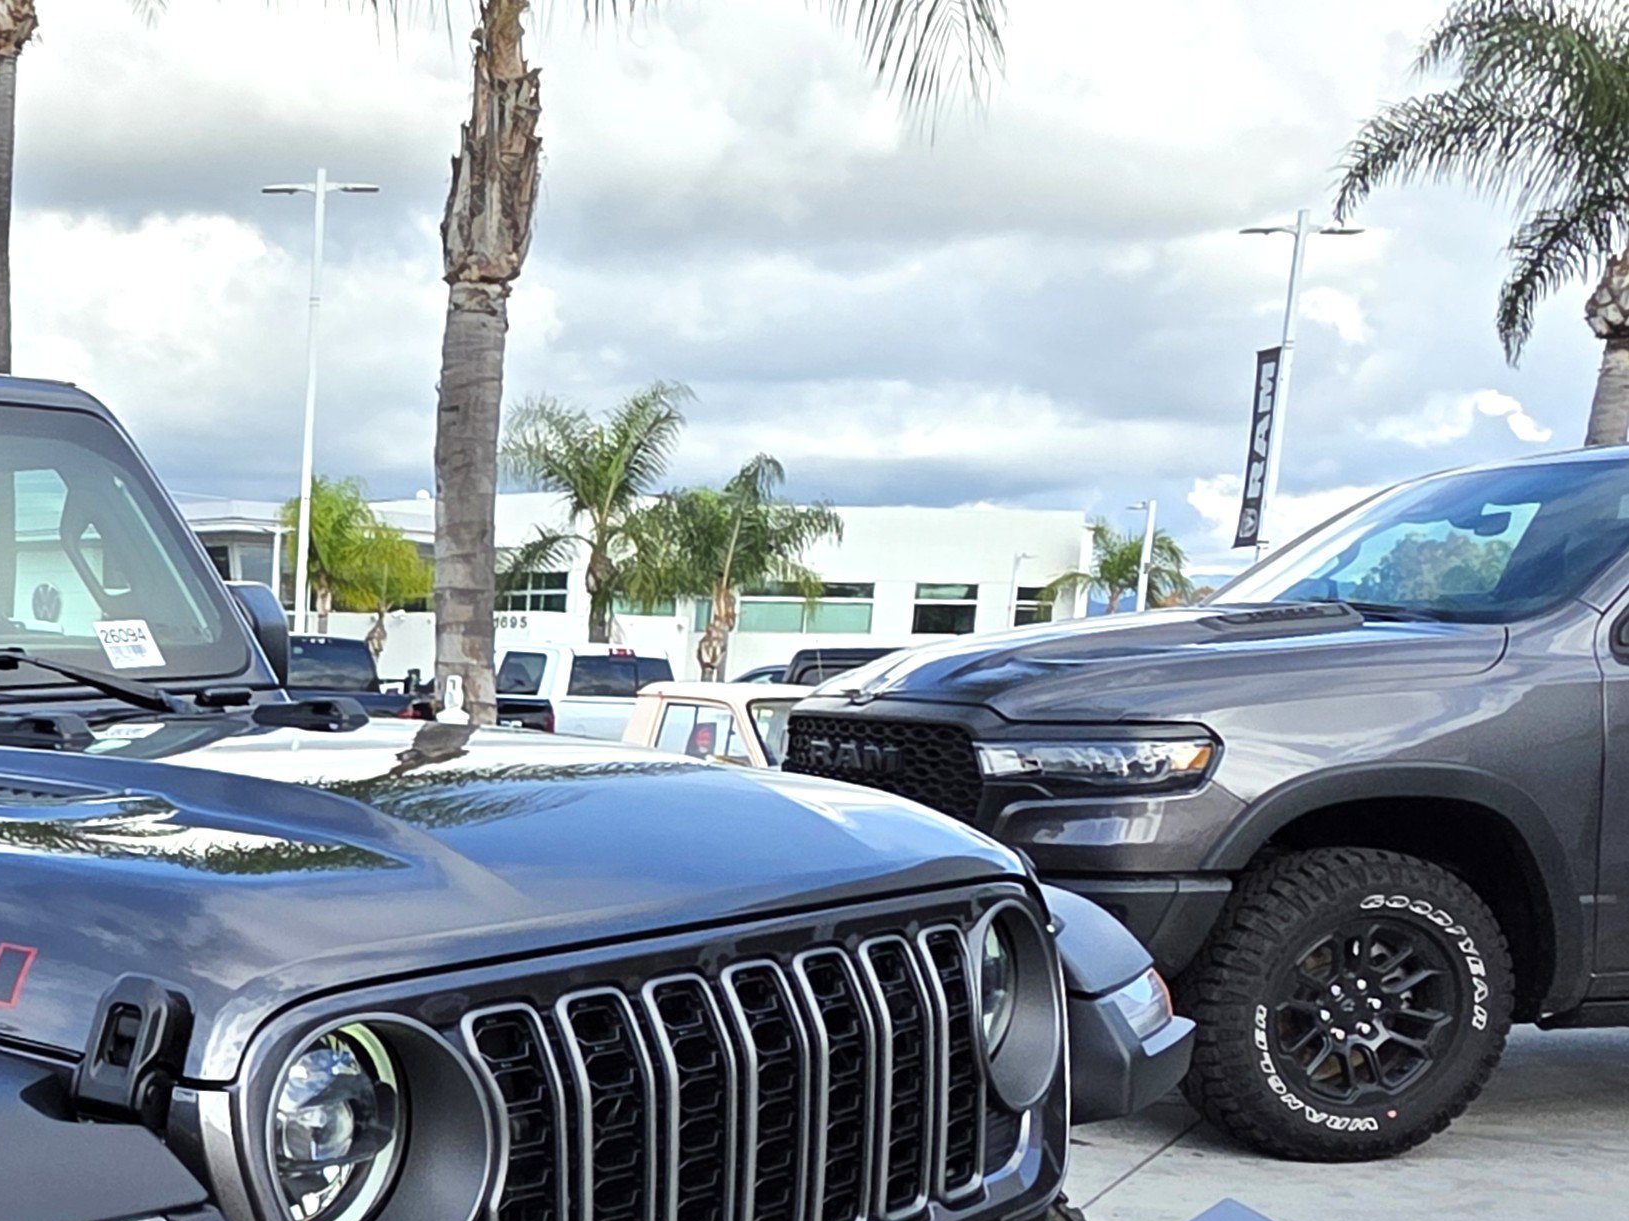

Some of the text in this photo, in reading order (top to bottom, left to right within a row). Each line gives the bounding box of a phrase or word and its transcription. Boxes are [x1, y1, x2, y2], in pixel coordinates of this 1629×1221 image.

[1246, 361, 1277, 499] RAM
[100, 627, 147, 644] 26094
[809, 737, 903, 771] RAM
[1360, 894, 1489, 1031] GOODYEAR
[1255, 1004, 1379, 1131] WRANGLER
